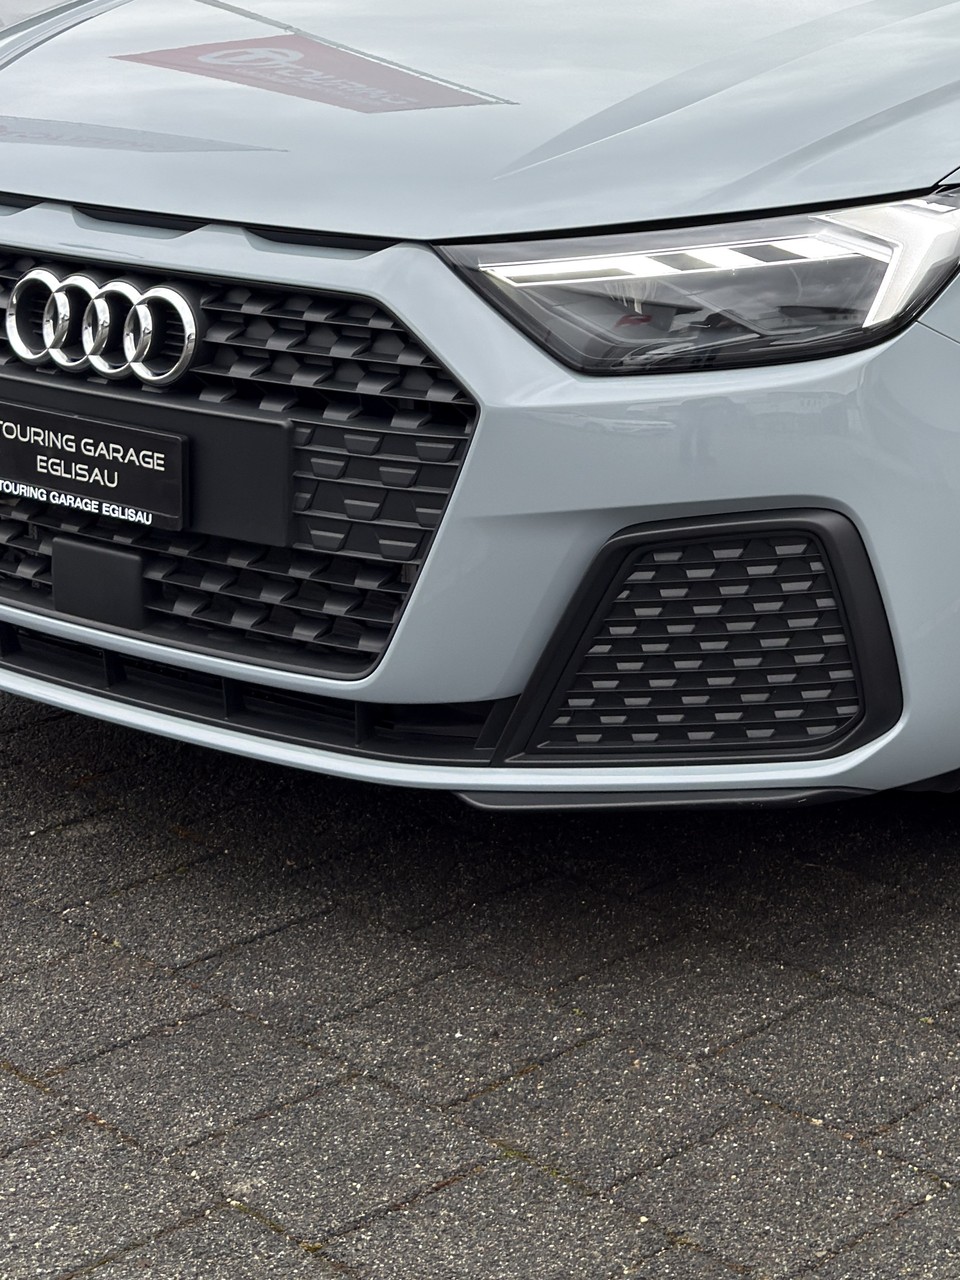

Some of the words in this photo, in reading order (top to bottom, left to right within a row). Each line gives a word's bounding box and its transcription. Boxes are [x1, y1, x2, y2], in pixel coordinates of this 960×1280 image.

[36, 454, 118, 488] EGLISAU
[81, 438, 166, 471] GARAGE
[49, 491, 99, 513] GARAGE
[102, 502, 152, 525] EGLISAU
